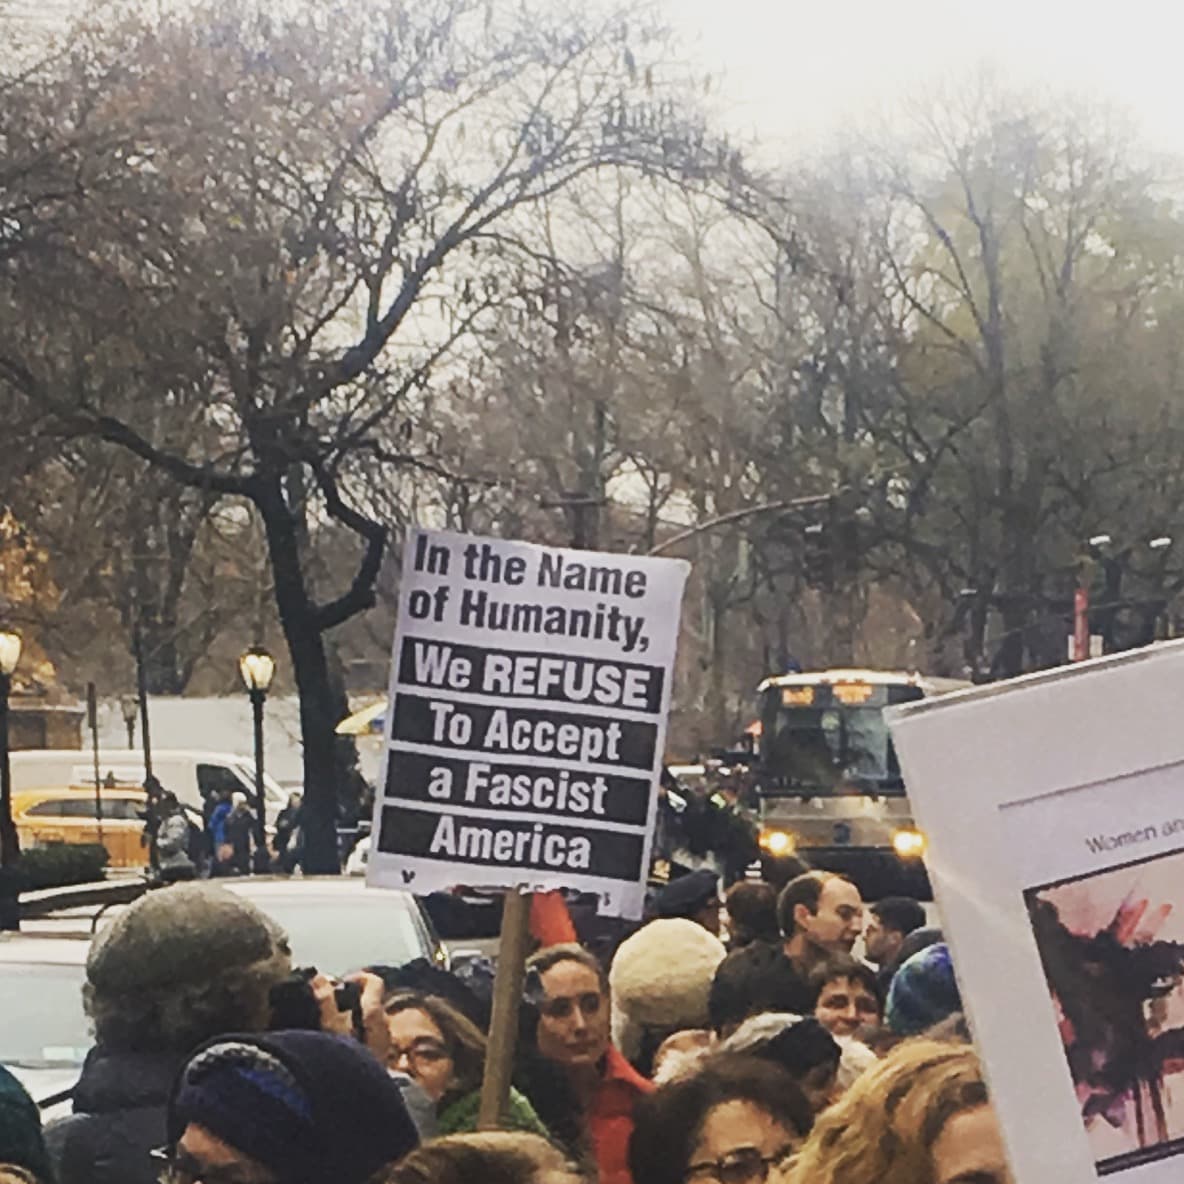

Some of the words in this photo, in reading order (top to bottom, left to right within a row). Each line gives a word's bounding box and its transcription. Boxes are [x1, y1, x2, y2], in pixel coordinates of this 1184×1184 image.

[414, 534, 451, 576] In
[463, 543, 527, 587] the
[536, 551, 648, 599] Name
[408, 585, 450, 623] of
[459, 588, 651, 654] Humanity,
[413, 642, 473, 689] We
[482, 653, 652, 709] REFUSE
[429, 701, 473, 746] To
[483, 709, 623, 764] Accept
[427, 766, 453, 800] a
[464, 763, 608, 816] Fascist
[429, 815, 592, 869] America
[1085, 824, 1158, 854] Women
